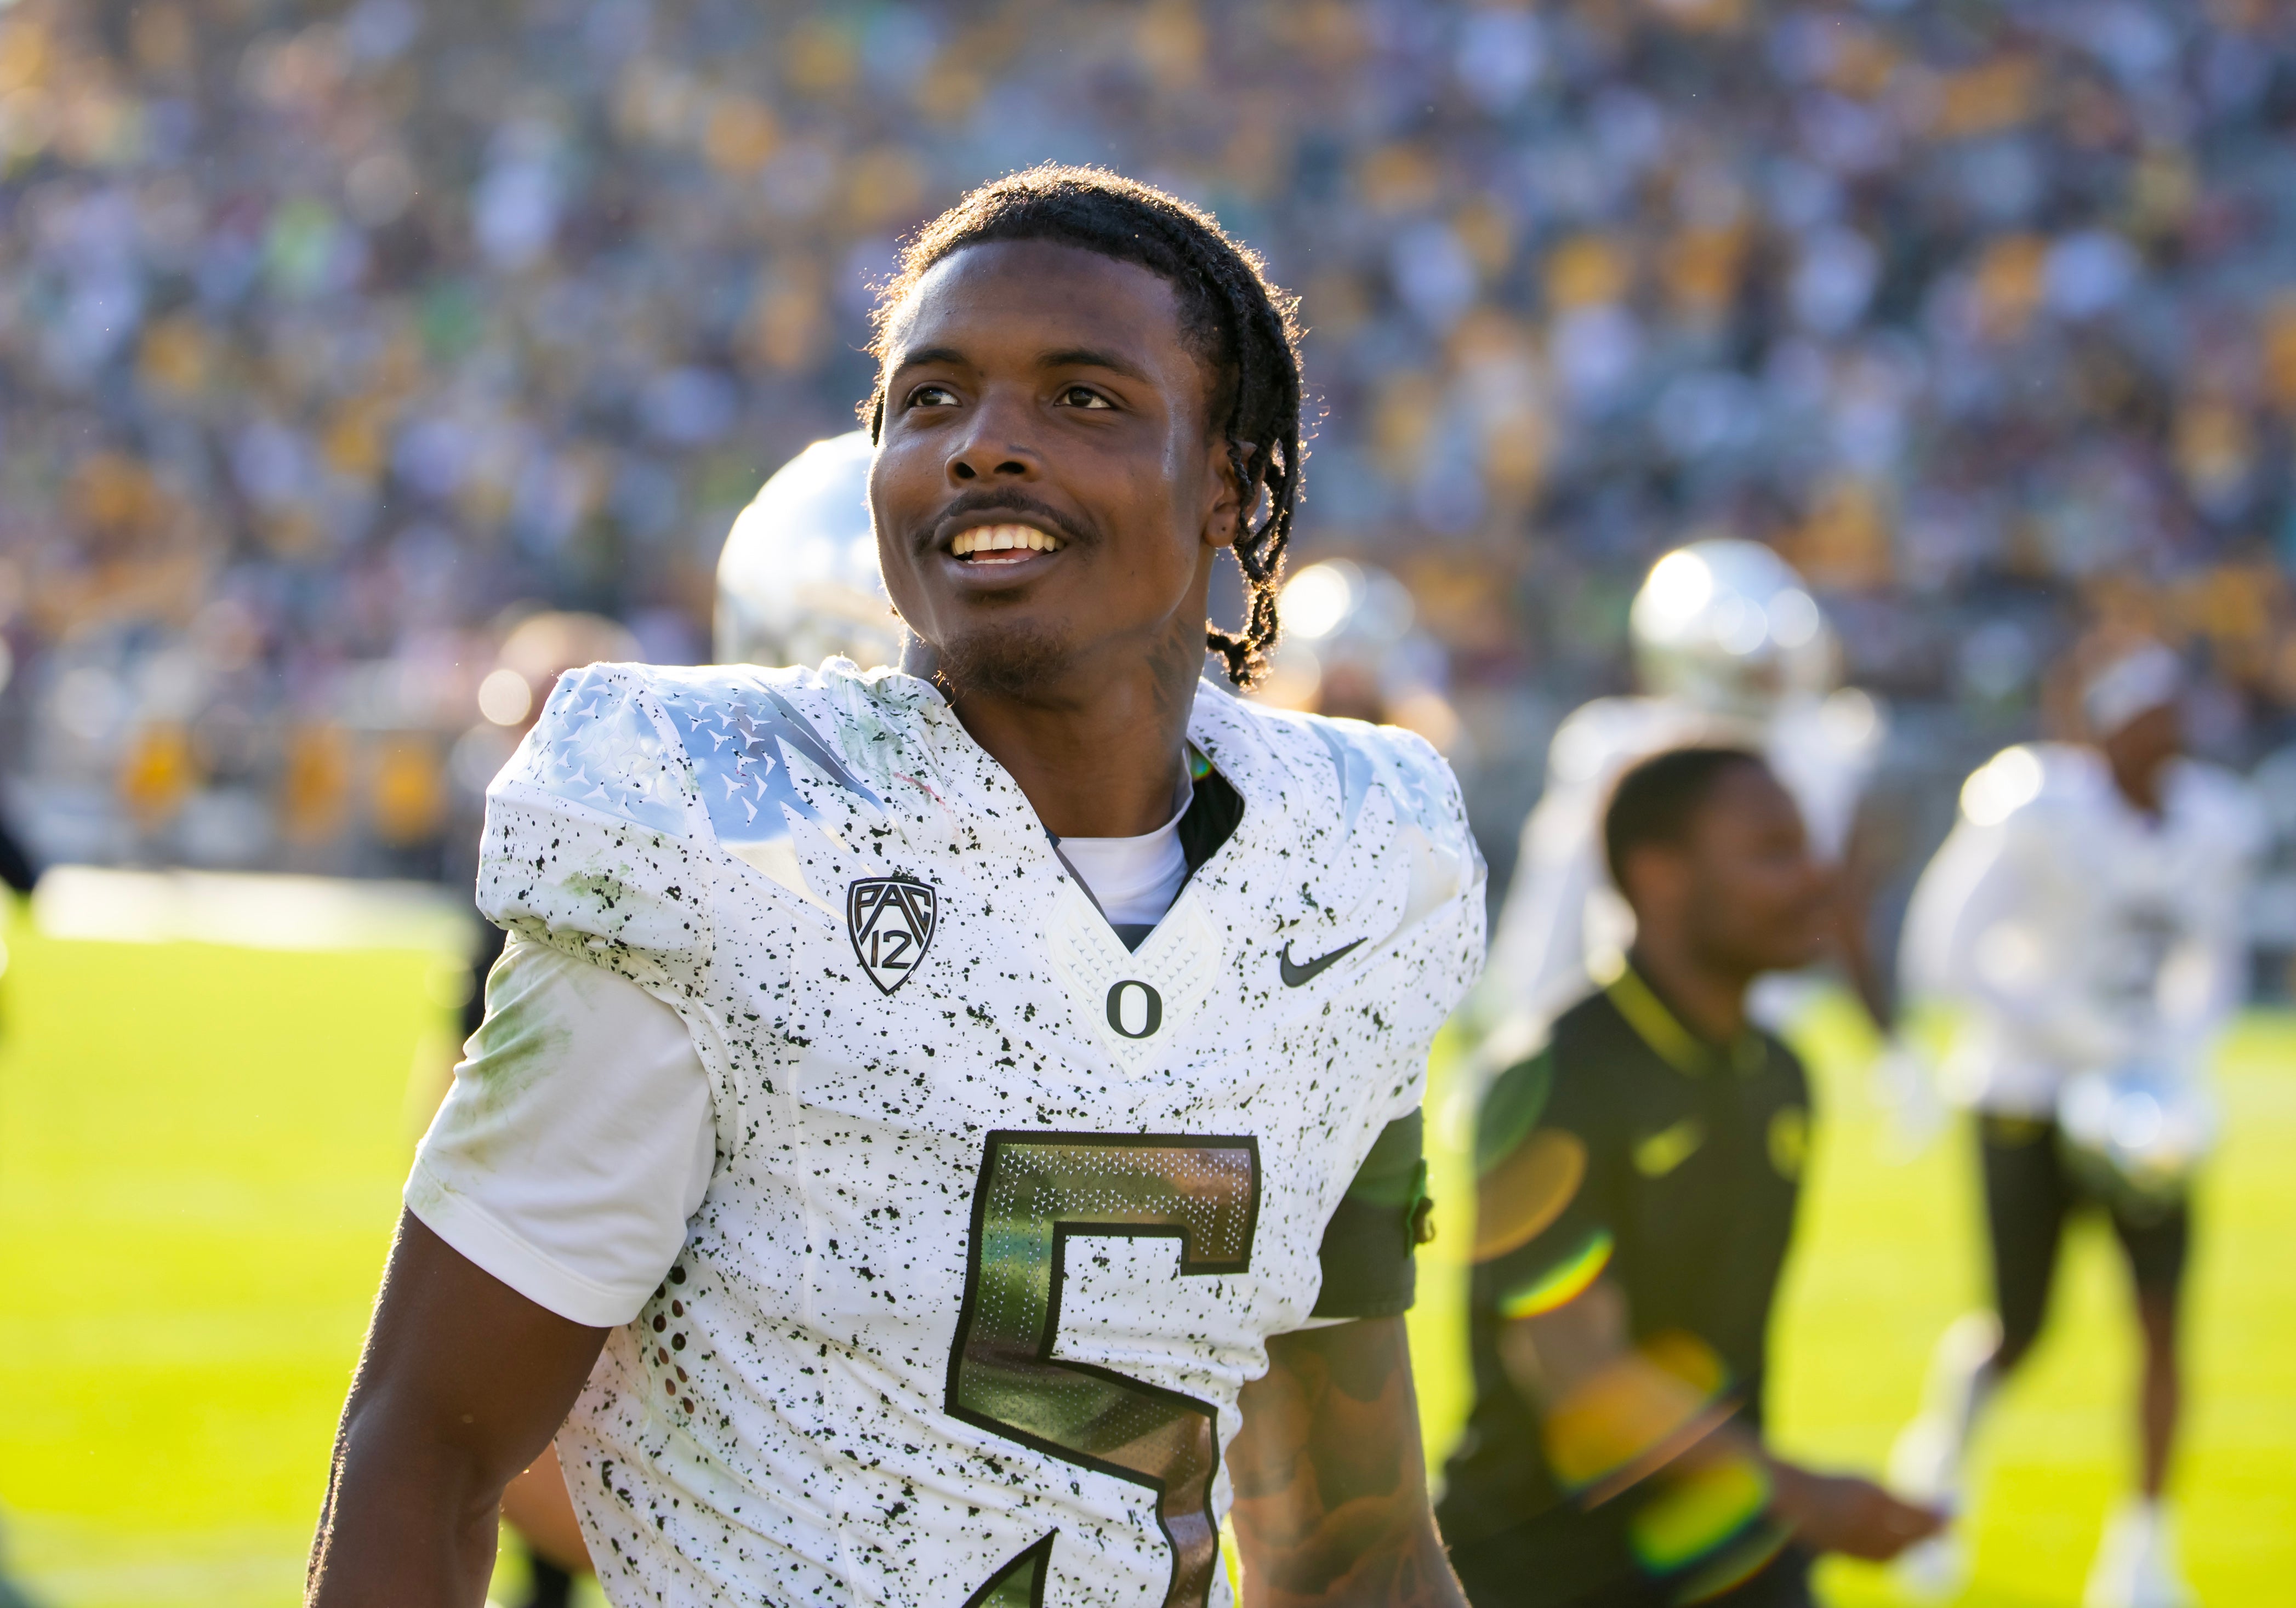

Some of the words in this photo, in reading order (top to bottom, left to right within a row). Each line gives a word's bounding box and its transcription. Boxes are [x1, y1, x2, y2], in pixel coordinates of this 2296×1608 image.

[854, 883, 931, 950] PAC
[870, 930, 912, 969] 12
[1106, 980, 1163, 1039] O
[944, 1130, 1262, 1608] 5
